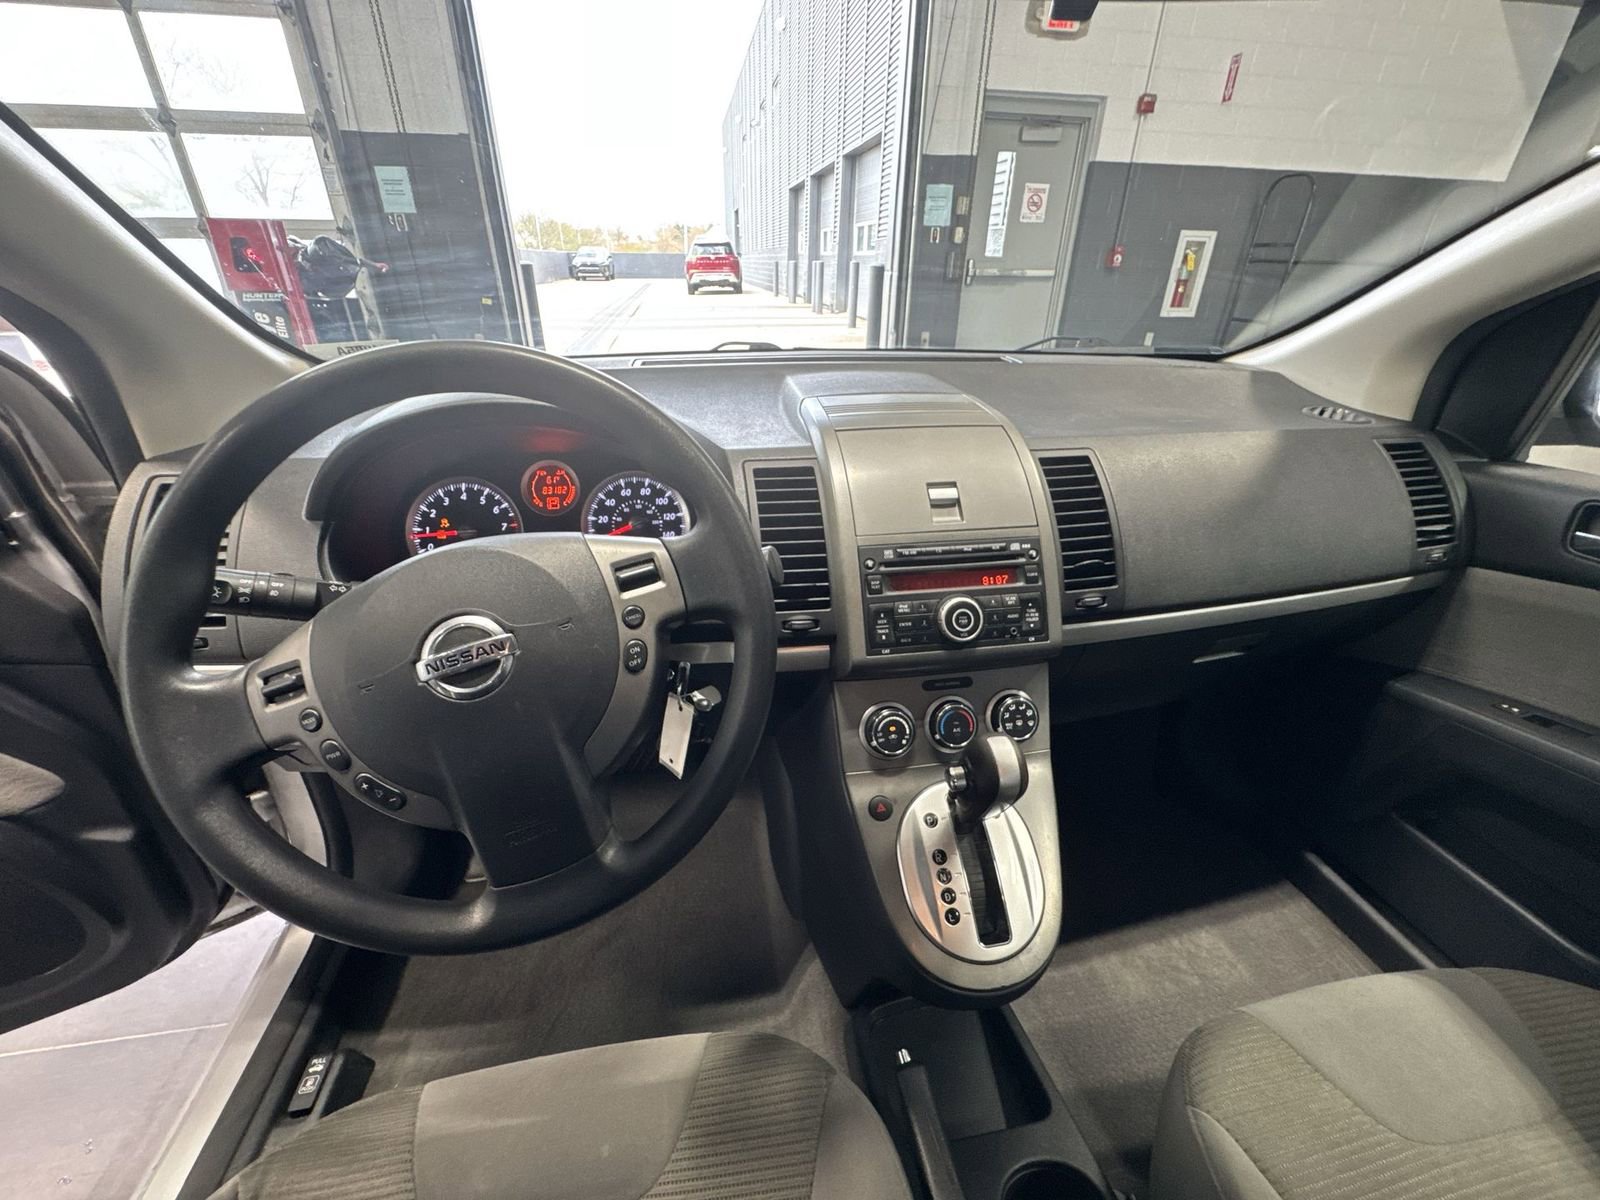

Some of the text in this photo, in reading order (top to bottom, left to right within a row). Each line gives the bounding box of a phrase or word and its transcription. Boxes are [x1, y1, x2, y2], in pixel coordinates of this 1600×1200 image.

[542, 486, 567, 495] 83102
[620, 488, 632, 497] 60
[640, 487, 651, 496] 80
[443, 497, 450, 505] 3
[480, 496, 486, 505] 5
[604, 498, 616, 507] 40
[655, 497, 669, 506] 100
[430, 509, 437, 518] 2
[493, 505, 500, 514] 6
[598, 515, 609, 524] 20
[663, 512, 676, 521] 120
[501, 522, 508, 531] 7
[982, 574, 1009, 586] 8:07
[629, 646, 641, 654] ON
[424, 640, 511, 675] NISSAN
[628, 658, 642, 667] OFF
[926, 815, 934, 826] P
[939, 872, 947, 881] N
[944, 892, 952, 902] D
